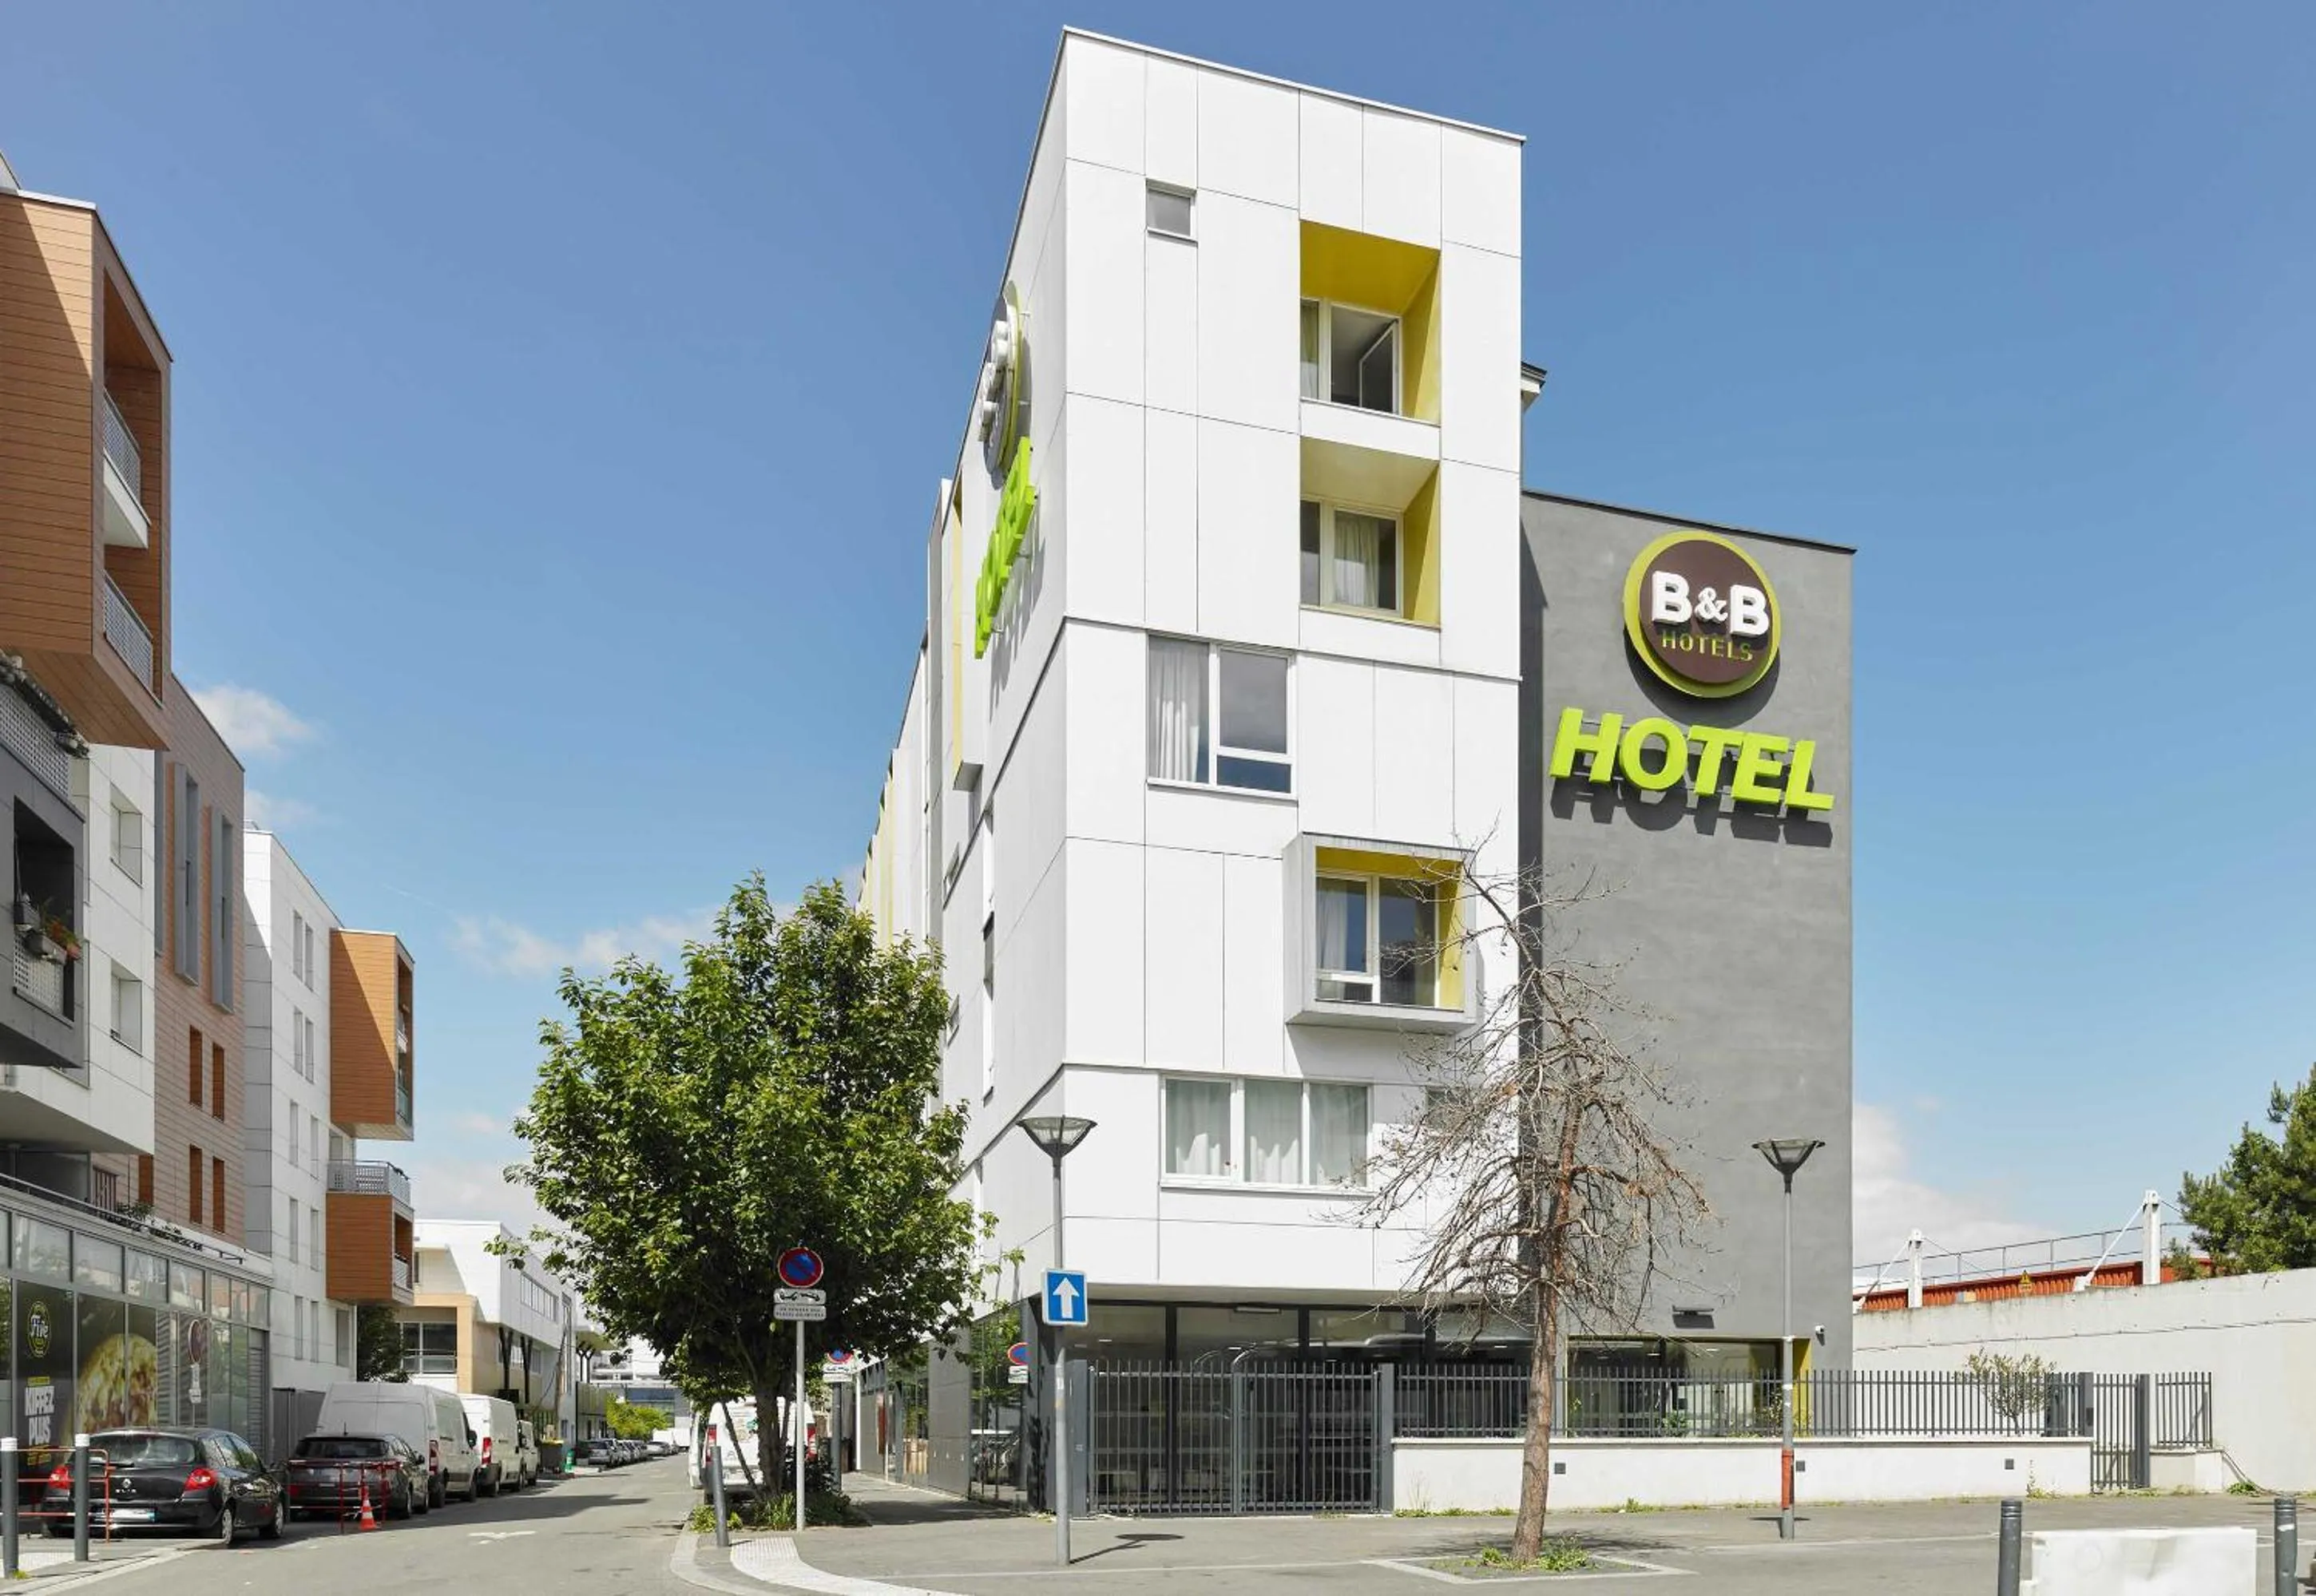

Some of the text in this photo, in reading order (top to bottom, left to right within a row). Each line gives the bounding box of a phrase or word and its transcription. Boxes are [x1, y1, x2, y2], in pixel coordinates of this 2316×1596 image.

[1652, 570, 1770, 638] B&B
[1662, 630, 1754, 662] HOTELS
[1549, 707, 1834, 810] HOTEL
